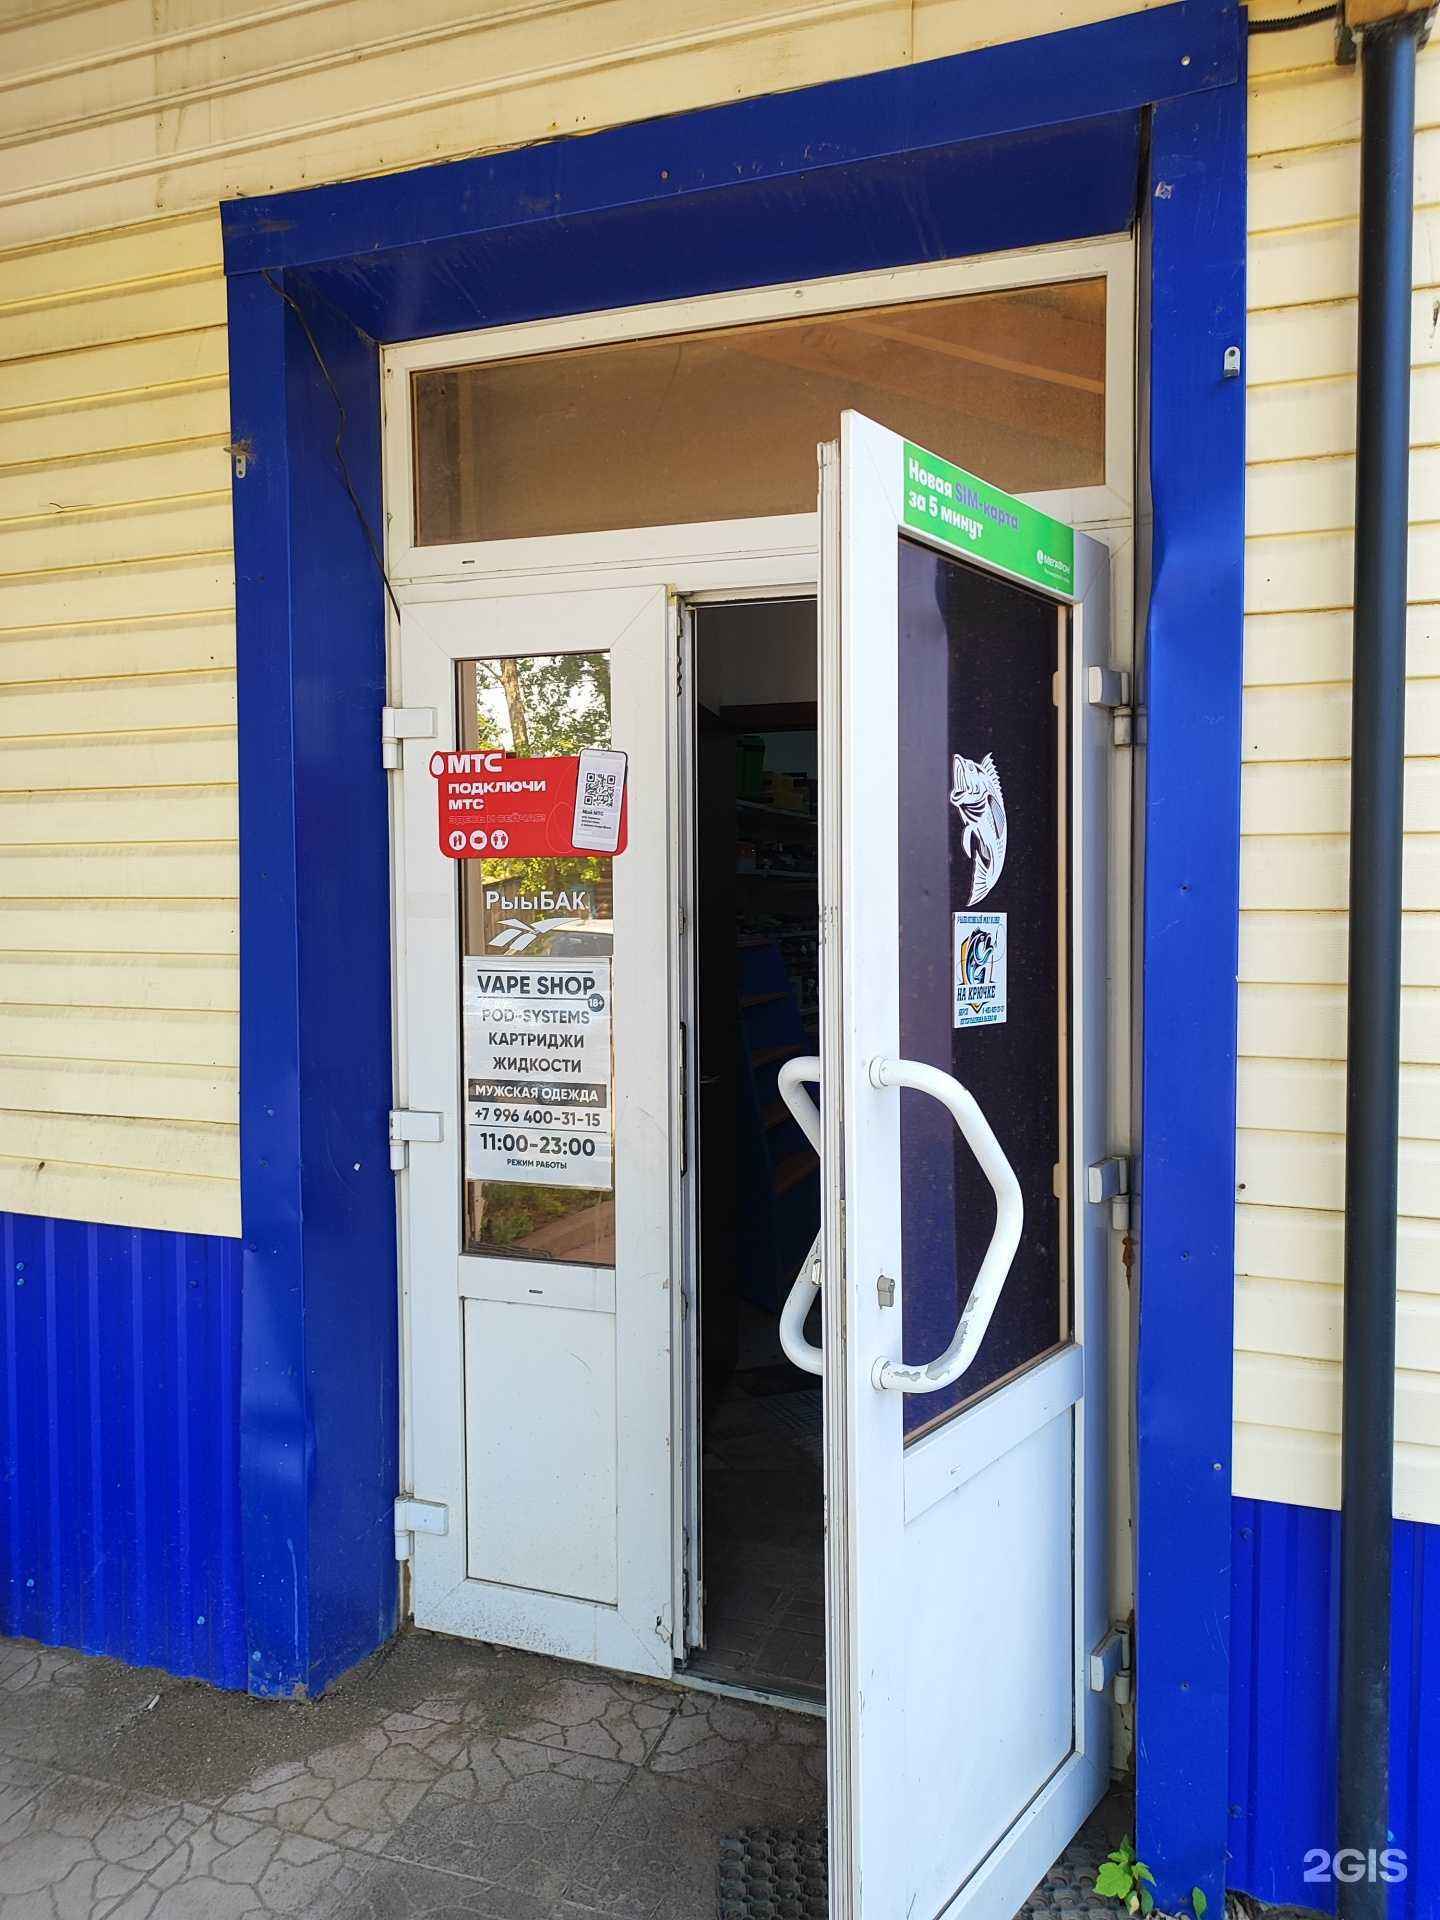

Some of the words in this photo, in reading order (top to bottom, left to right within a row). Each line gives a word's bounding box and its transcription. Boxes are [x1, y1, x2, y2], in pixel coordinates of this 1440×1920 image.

[909, 457, 953, 498] Новая
[955, 481, 1020, 530] SIM-карта
[909, 491, 926, 512] за
[929, 497, 938, 518] 5
[941, 505, 984, 540] минут
[448, 753, 502, 774] МТС
[448, 798, 485, 811] МТС
[477, 975, 530, 994] VAPE
[536, 976, 596, 996] SHOP
[957, 986, 966, 1001] НА
[968, 985, 996, 1001] КРЮЧКЕ
[588, 999, 604, 1009] 18+
[482, 1009, 590, 1025] POD-SYSTEMS
[488, 1032, 584, 1049] КАРТРИДЖИ
[493, 1056, 582, 1074] ЖИДКОСТИ
[475, 1085, 539, 1100] МУЖСКАЯ
[541, 1087, 599, 1102] ОДЕЖДА
[475, 1108, 490, 1122] +7
[493, 1108, 520, 1124] 996
[523, 1110, 601, 1127] 400-31-15
[480, 1132, 596, 1157] 11:00-23:00
[506, 1158, 535, 1169] РЕЖИМ
[535, 1160, 568, 1170] РАБОТЫ
